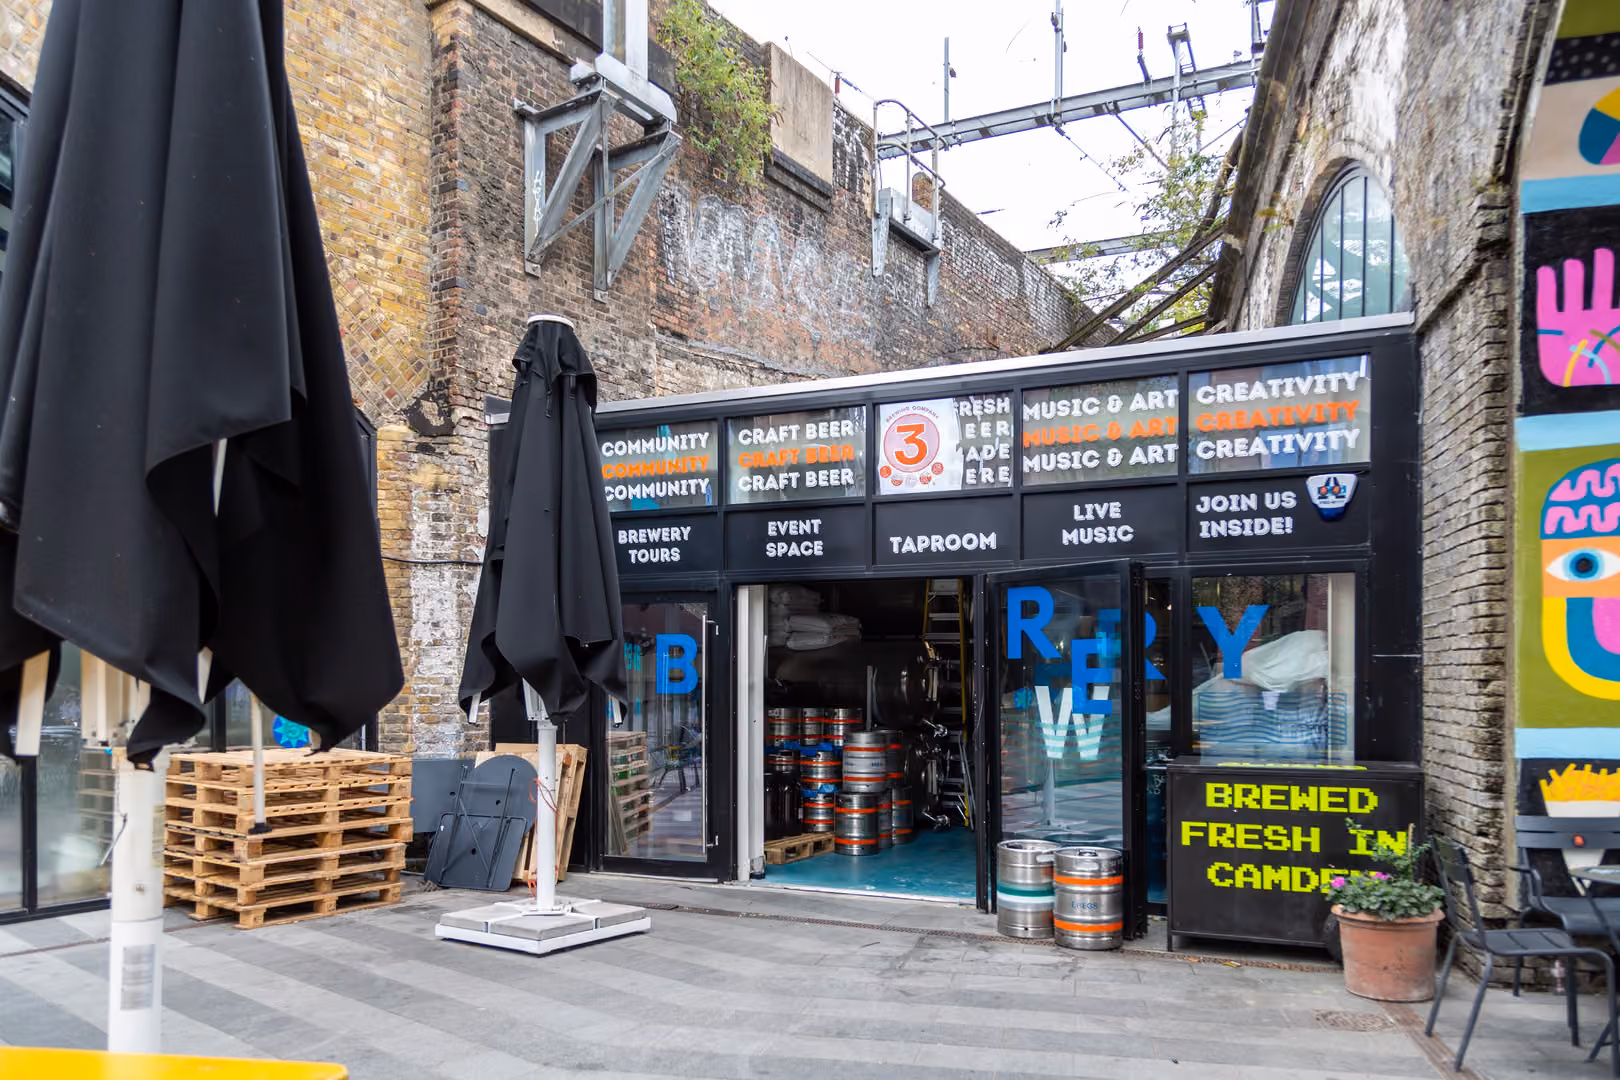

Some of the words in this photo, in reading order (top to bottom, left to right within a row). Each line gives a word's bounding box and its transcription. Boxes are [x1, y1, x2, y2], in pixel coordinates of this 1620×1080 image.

[1196, 371, 1360, 405] CREATIVITY
[1023, 397, 1100, 421] MUSIC
[1107, 395, 1123, 412] &
[1129, 389, 1179, 411] ART
[1196, 400, 1360, 432] CREATIVITY
[737, 424, 800, 445] CRAFT
[805, 419, 855, 441] BEER
[965, 421, 1010, 439] EER
[1023, 423, 1100, 447] MUSIC
[1106, 422, 1123, 440] &
[1129, 417, 1179, 438] ART
[601, 432, 709, 457] COMMUNITY
[737, 449, 800, 468] CRAFT
[805, 444, 855, 463] BEER
[895, 424, 927, 465] 3
[958, 443, 1010, 462] ADE
[1196, 428, 1360, 460] CREATIVITY
[601, 455, 709, 479] COMMUNITY
[1023, 450, 1100, 473] MUSIC
[1106, 448, 1123, 466] &
[1129, 443, 1179, 465] ART
[737, 472, 800, 492] CRAFT
[805, 468, 855, 488] BEER
[965, 466, 1010, 484] ERE
[604, 478, 709, 501] COMMUNITY
[1073, 501, 1122, 521] LIVE
[1196, 492, 1258, 514] JOIN
[1264, 491, 1297, 510] US
[618, 526, 691, 546] BREWERY
[767, 519, 822, 537] EVENT
[1062, 525, 1135, 546] MUSIC
[1199, 516, 1294, 539] INSIDE!
[628, 546, 681, 564] TOURS
[766, 540, 824, 558] SPACE
[890, 531, 997, 555] TAPROOM
[1205, 783, 1379, 814] BREWED
[1181, 821, 1320, 852] FRESH
[1348, 828, 1408, 857] IN
[1207, 862, 1379, 894] CAMDE
